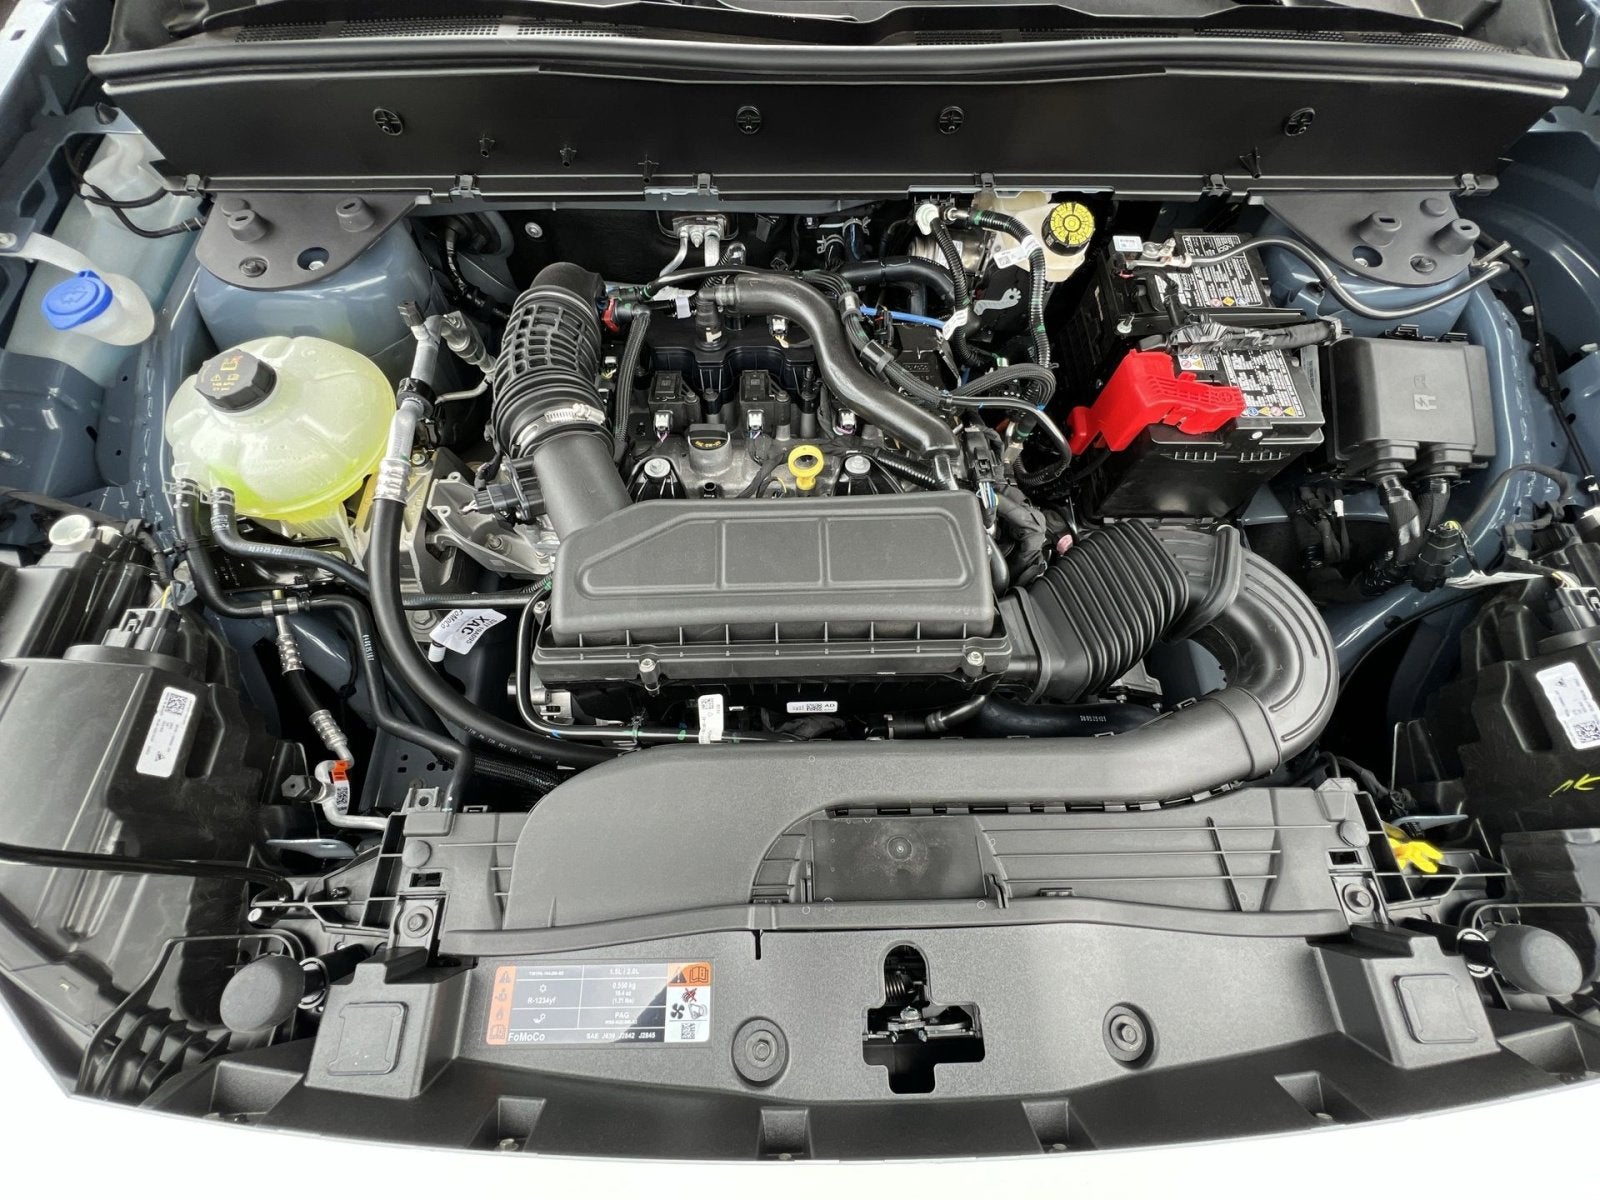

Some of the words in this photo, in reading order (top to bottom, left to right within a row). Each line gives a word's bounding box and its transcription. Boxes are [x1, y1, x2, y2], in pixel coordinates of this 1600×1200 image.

[461, 615, 490, 635] XAC
[527, 996, 557, 1005] R-1234yf
[614, 1011, 630, 1019] PAG
[508, 1031, 546, 1042] FoMoCo
